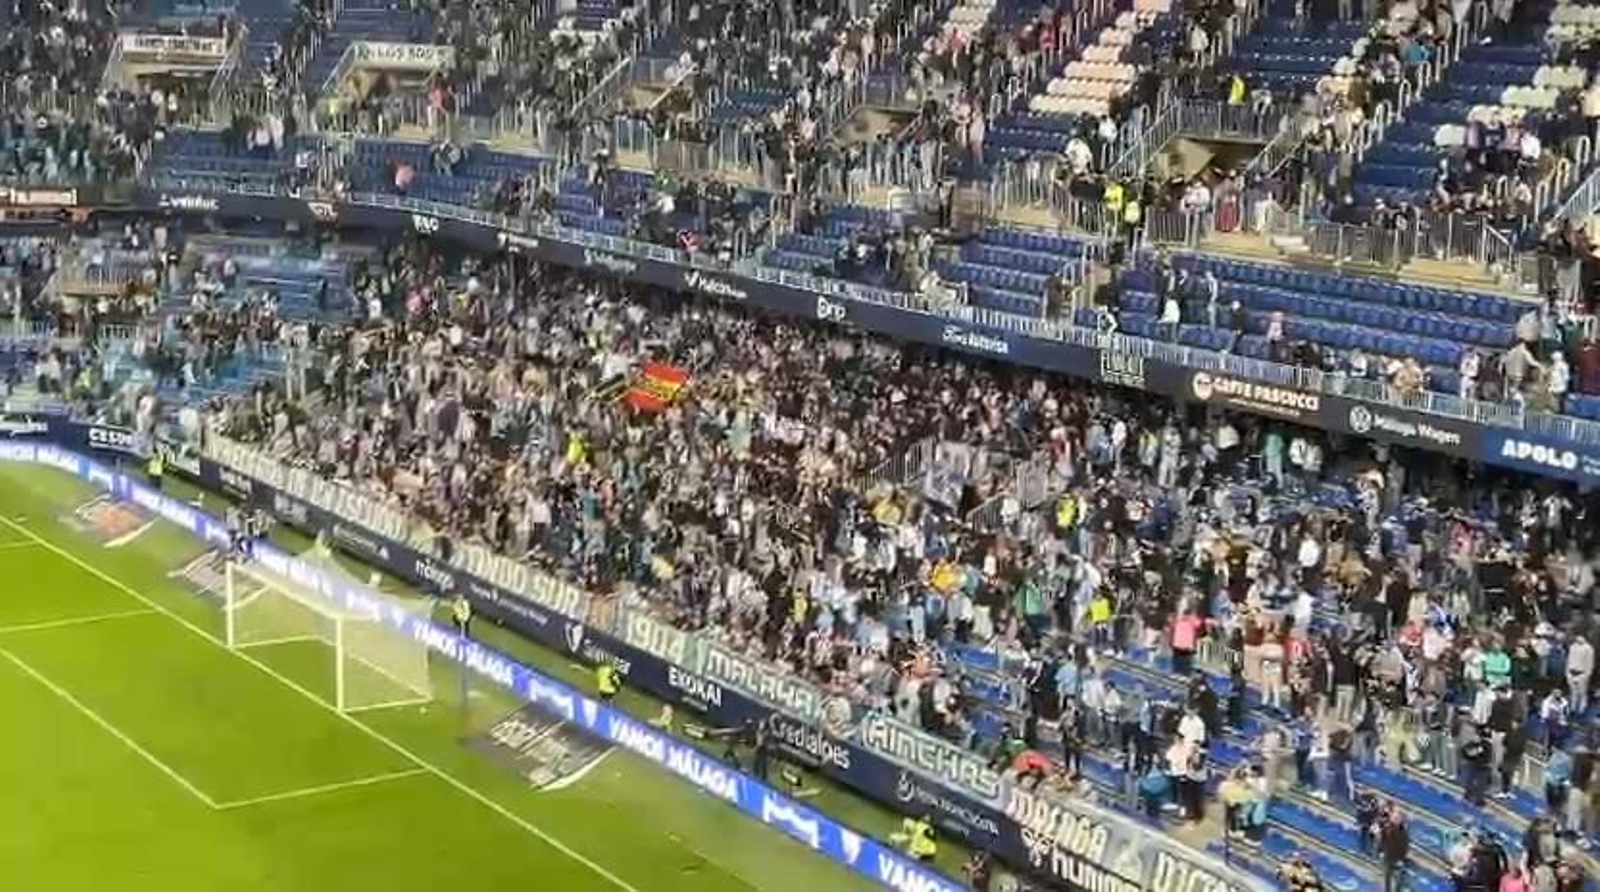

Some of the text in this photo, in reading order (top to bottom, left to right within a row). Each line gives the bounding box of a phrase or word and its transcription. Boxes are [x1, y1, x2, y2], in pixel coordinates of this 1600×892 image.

[1502, 439, 1578, 470] APOLO
[609, 716, 665, 766] VAMOS
[878, 852, 953, 892] VAM
